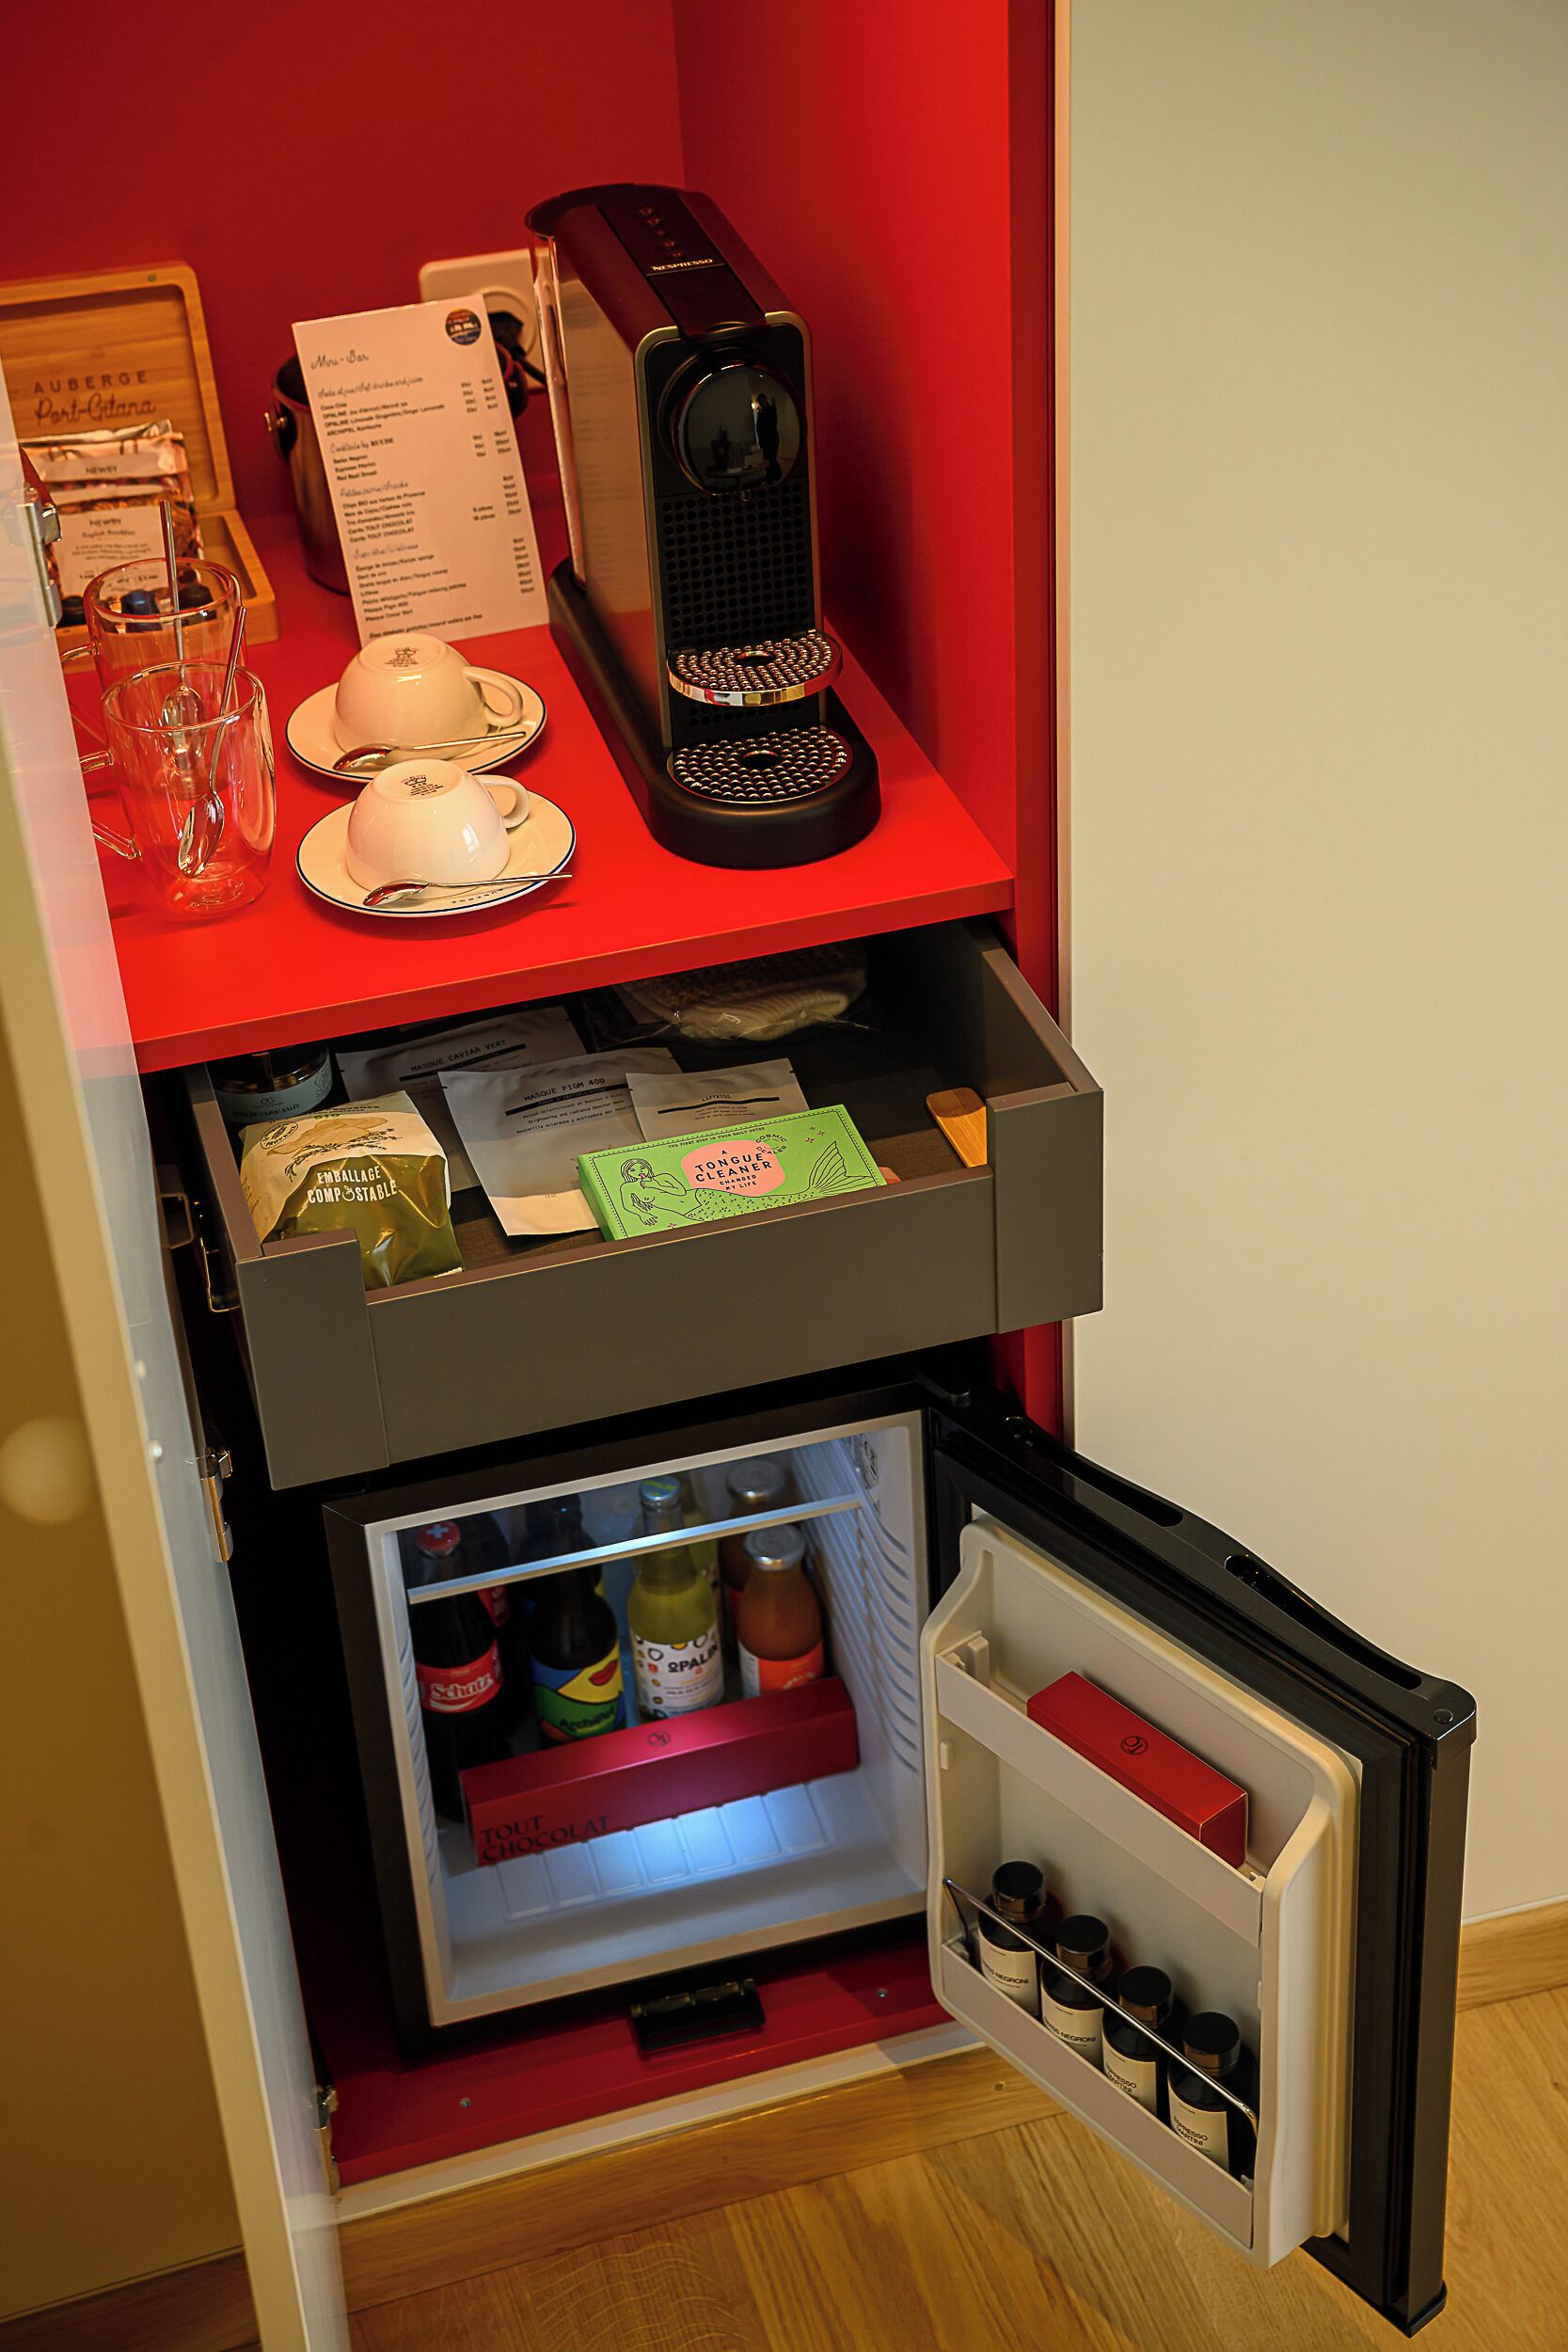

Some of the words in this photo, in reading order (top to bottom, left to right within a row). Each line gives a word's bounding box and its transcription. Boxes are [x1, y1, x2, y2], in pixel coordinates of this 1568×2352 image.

[652, 259, 713, 271] NESPRESSO
[34, 370, 147, 393] AUBERGE
[34, 392, 156, 426] Port-Gitana
[410, 1058, 444, 1072] MASQUE
[448, 1046, 482, 1061] CAVIAR
[484, 1040, 506, 1051] VERT
[524, 1087, 558, 1102] MASQUE
[562, 1081, 584, 1091] PIGM
[755, 1134, 787, 1144] COSMIC
[756, 1145, 787, 1155] DEALER
[694, 1152, 764, 1172] TONGUE
[695, 1161, 772, 1183] CLEANER
[317, 1166, 381, 1184] EMBALLAGE
[720, 1174, 756, 1185] CHANGED
[739, 1181, 756, 1189] LIFE
[431, 1672, 494, 1701] Schatz
[480, 1815, 543, 1844] TOUT
[482, 1815, 611, 1862] CHOCOLAT
[995, 1971, 1029, 1984] NEGRONI
[1061, 2031, 1097, 2042] NEGRONI
[1176, 2125, 1203, 2146] MARTINI
